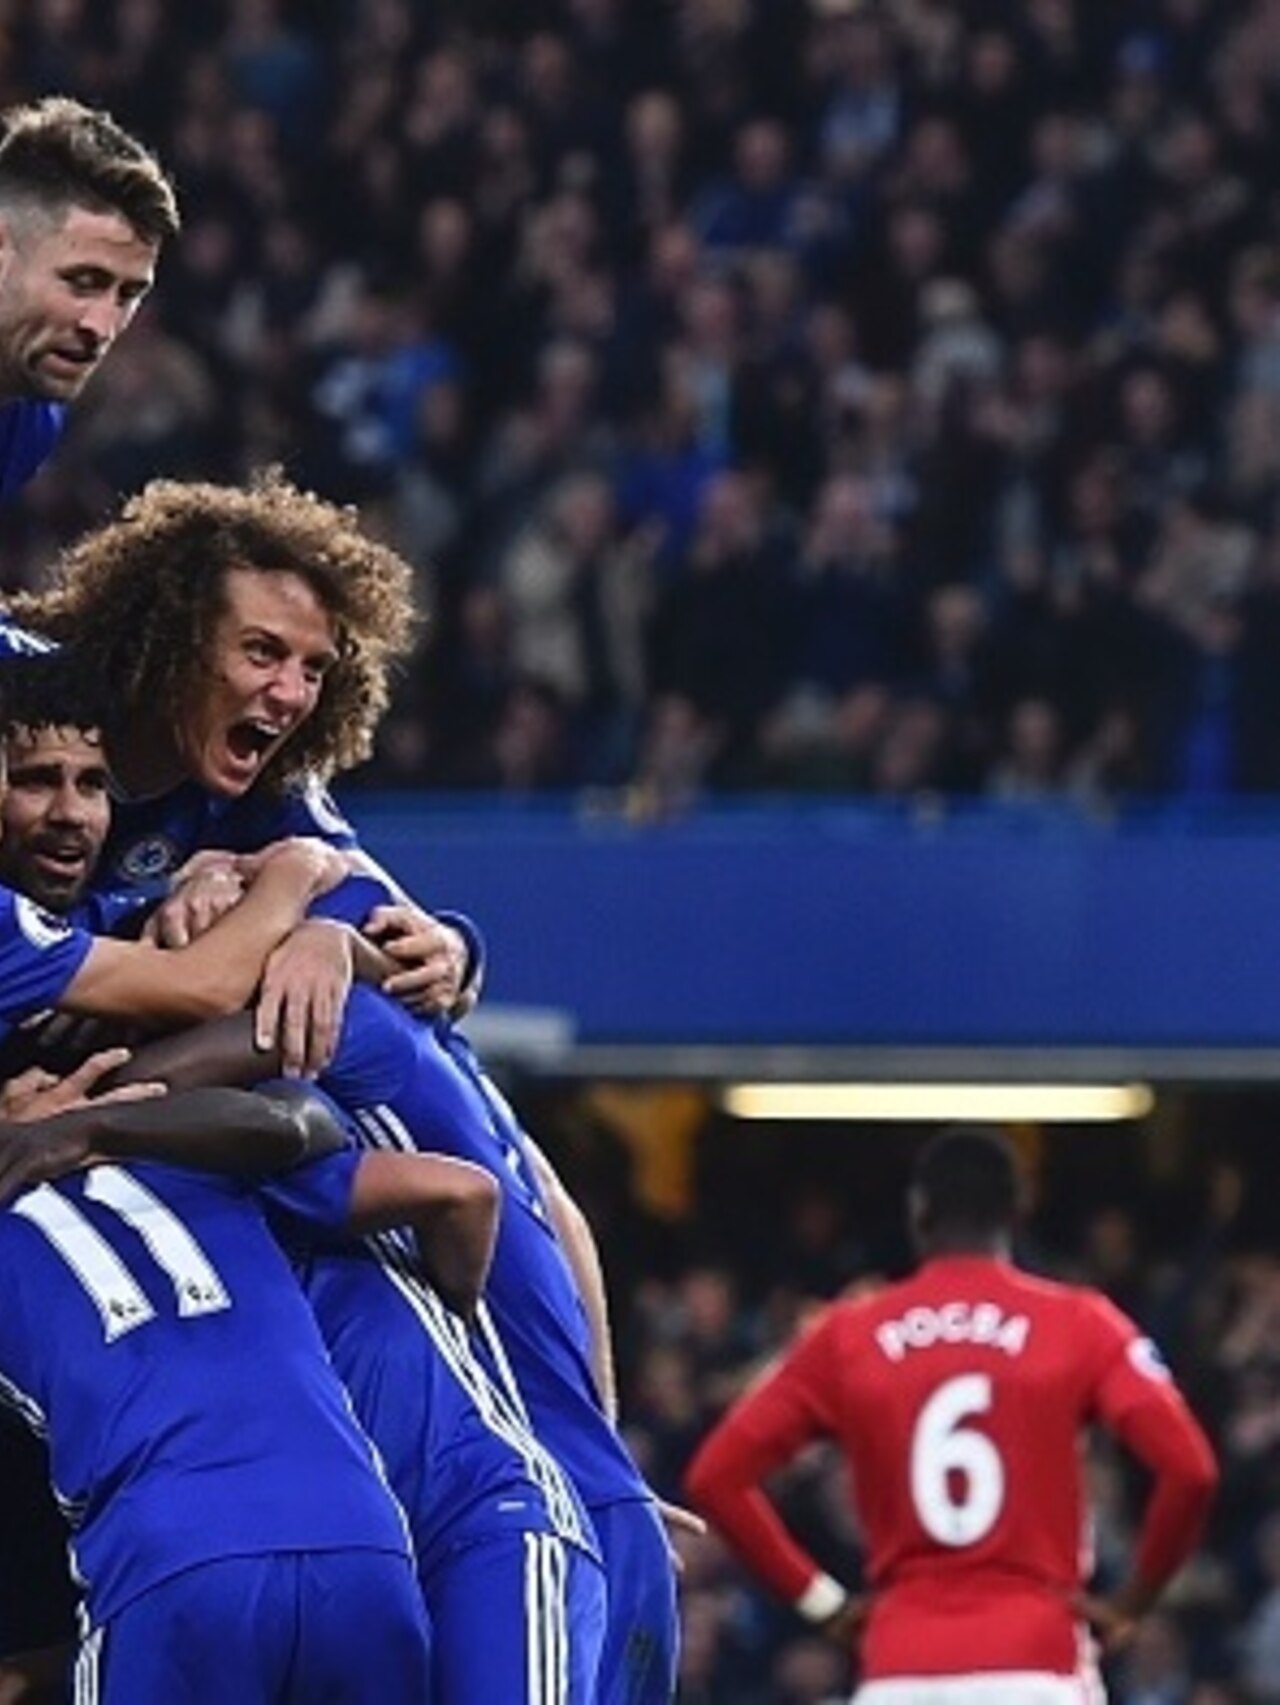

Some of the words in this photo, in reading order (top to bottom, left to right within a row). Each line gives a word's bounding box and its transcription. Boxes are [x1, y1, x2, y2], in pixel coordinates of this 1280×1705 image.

[10, 1165, 232, 1344] 11
[875, 1301, 1030, 1363] POGBA
[910, 1372, 1005, 1547] 6
